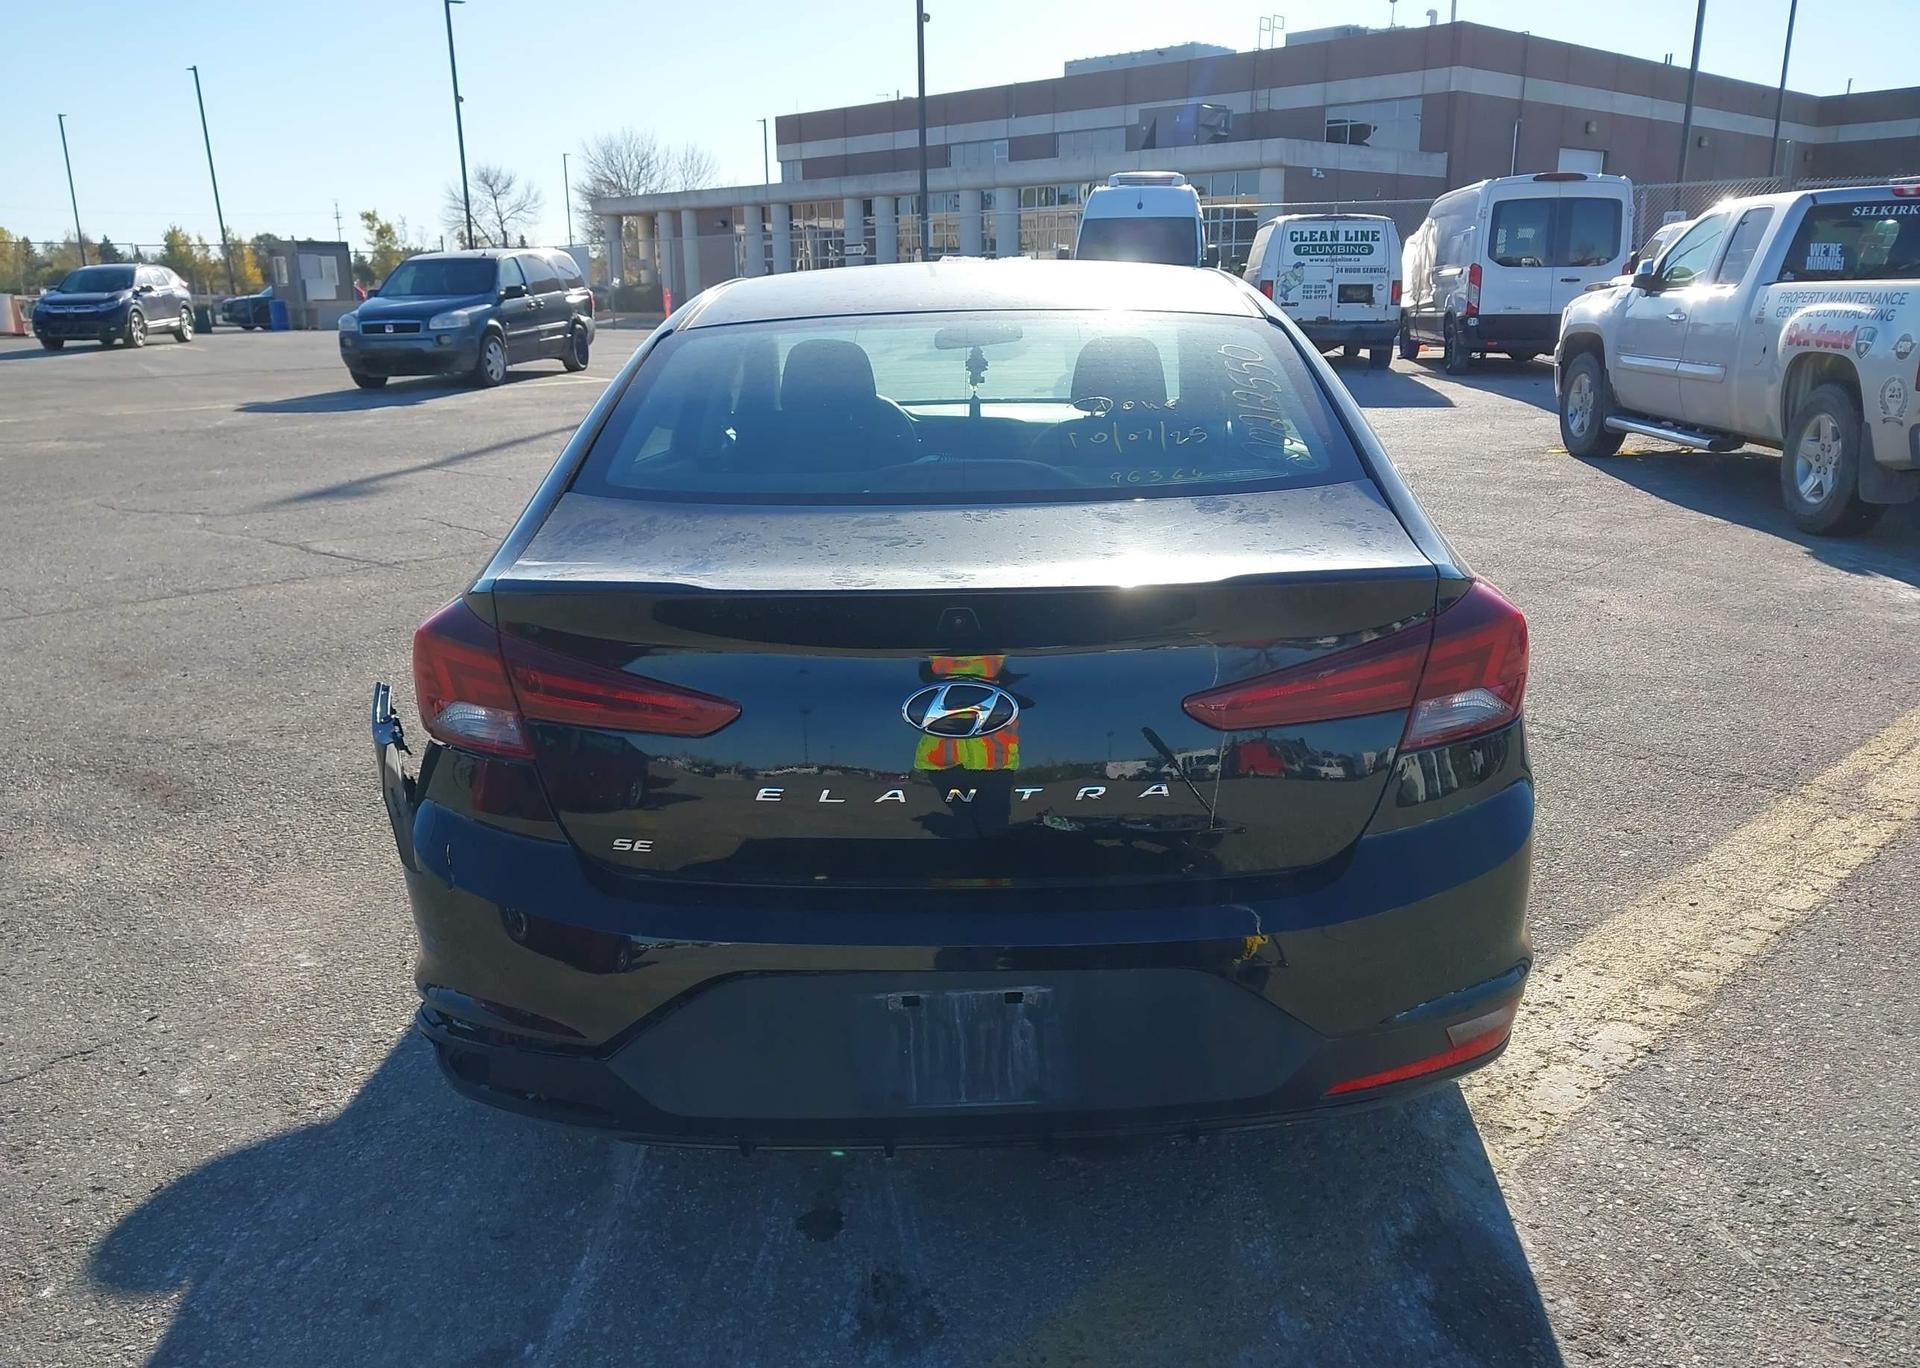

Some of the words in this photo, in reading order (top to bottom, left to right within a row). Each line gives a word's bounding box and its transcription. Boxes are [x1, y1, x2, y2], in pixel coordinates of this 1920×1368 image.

[1852, 204, 1920, 216] SELKIRK
[1290, 230, 1340, 242] CLEAN
[1344, 230, 1381, 242] LINE
[1300, 245, 1369, 254] PLUMBING
[1810, 243, 1842, 256] WE'RE
[1805, 256, 1845, 270] HIRING!
[1779, 291, 1829, 304] PROPERTY
[1827, 291, 1909, 306] MAINTENANCE
[1776, 306, 1815, 318] GENEAL
[755, 783, 1172, 803] ELANTRA
[612, 838, 654, 852] SE
